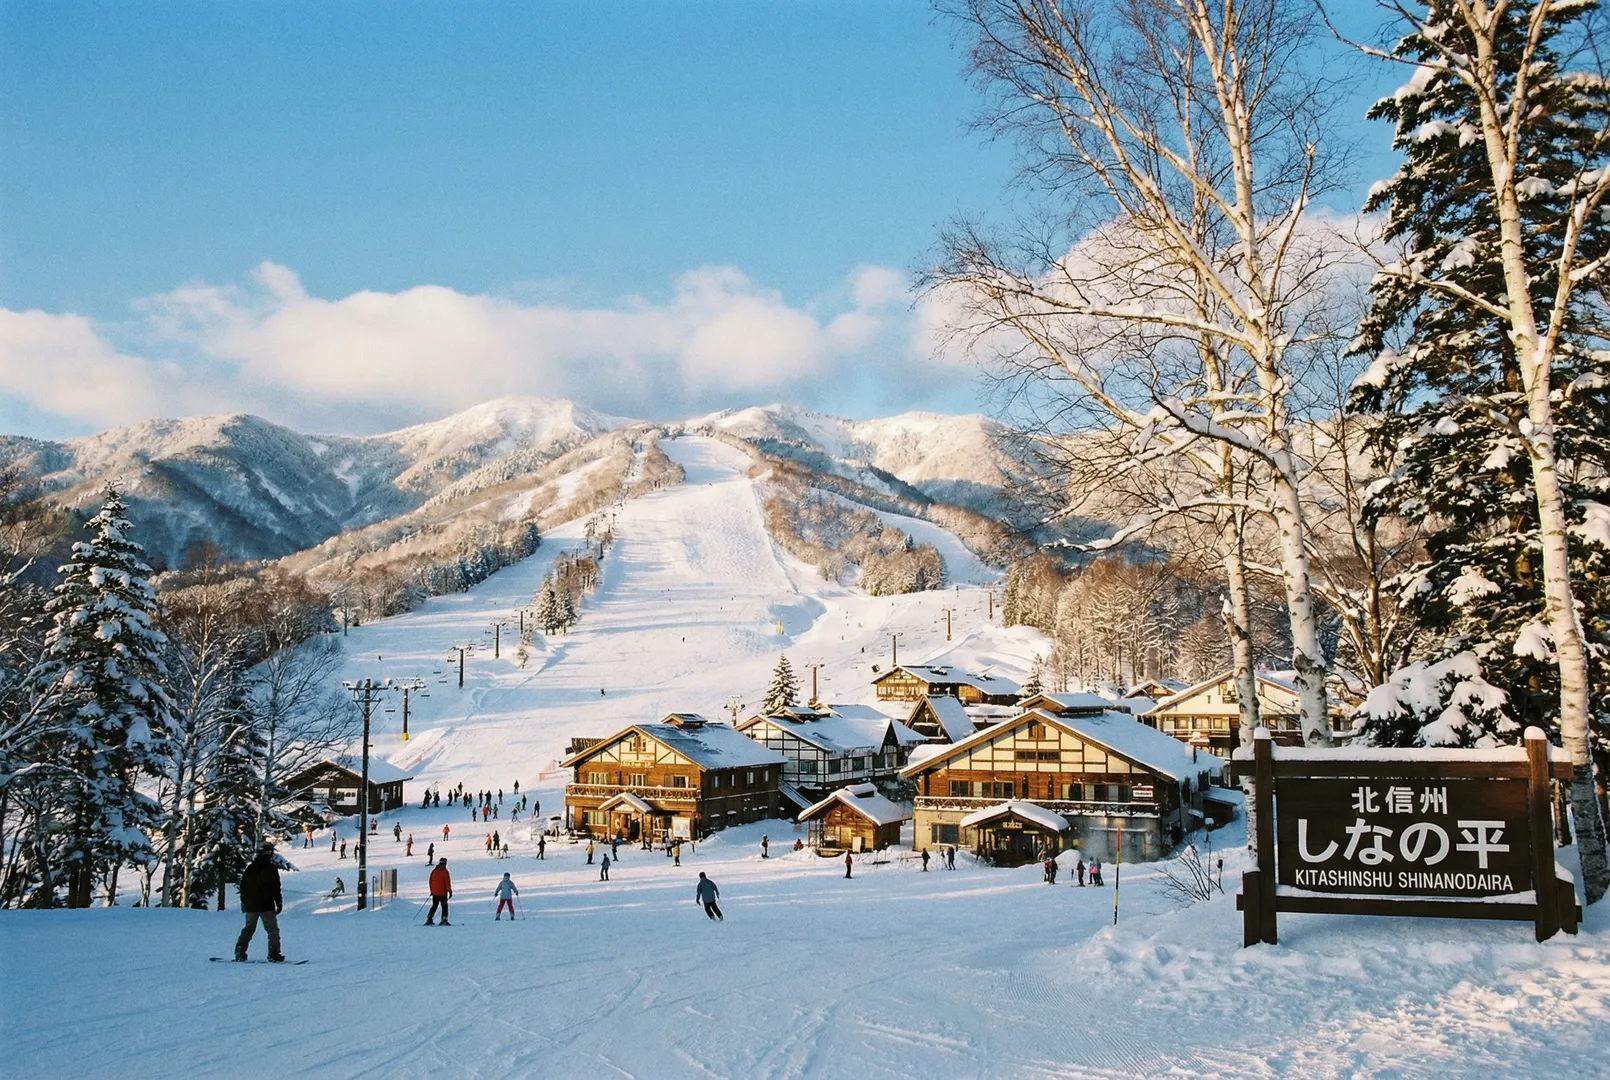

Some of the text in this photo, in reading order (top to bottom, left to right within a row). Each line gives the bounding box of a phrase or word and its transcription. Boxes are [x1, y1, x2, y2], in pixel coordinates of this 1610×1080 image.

[1351, 786, 1448, 815] 北信州
[1297, 818, 1510, 869] しなの平
[1295, 869, 1514, 891] KITASHINSHU SHINANODAIRA
